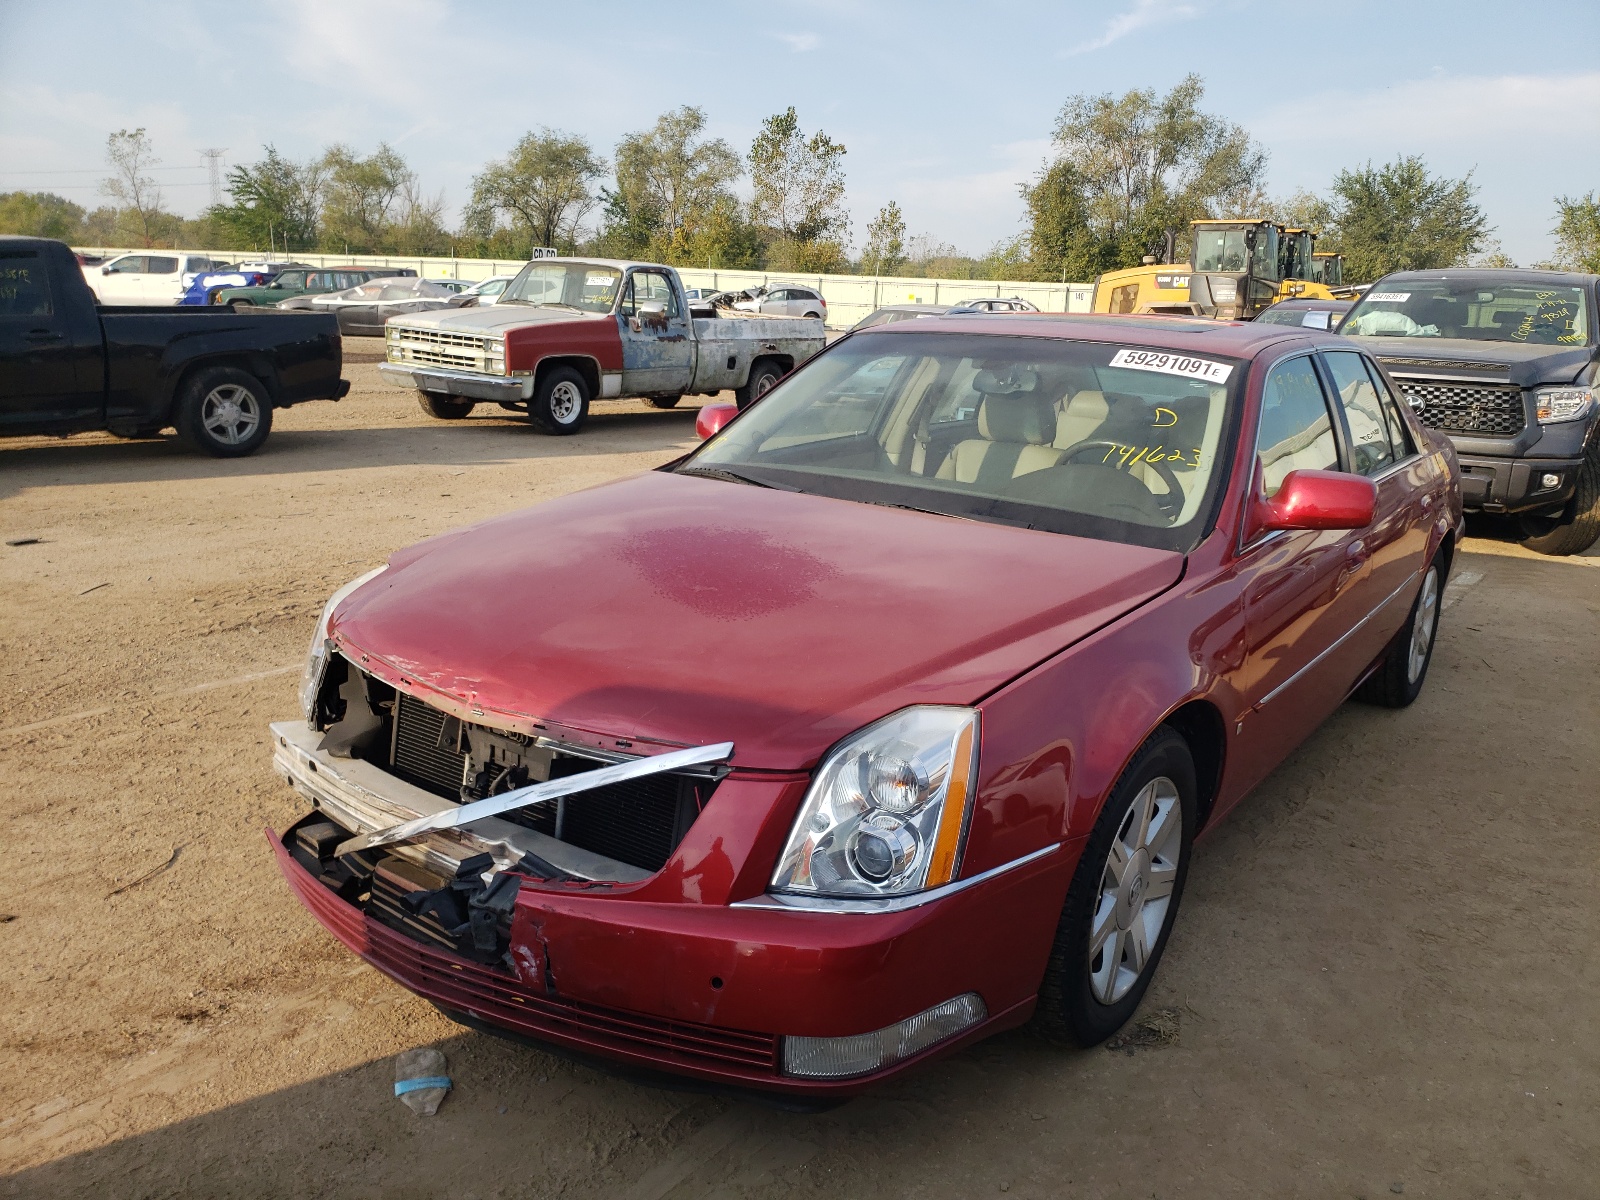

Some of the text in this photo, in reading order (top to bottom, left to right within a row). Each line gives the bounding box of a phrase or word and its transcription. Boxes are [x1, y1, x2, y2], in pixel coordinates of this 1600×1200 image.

[1173, 276, 1190, 288] CAT
[1124, 351, 1221, 377] 59291091 E
[1150, 407, 1178, 427] D
